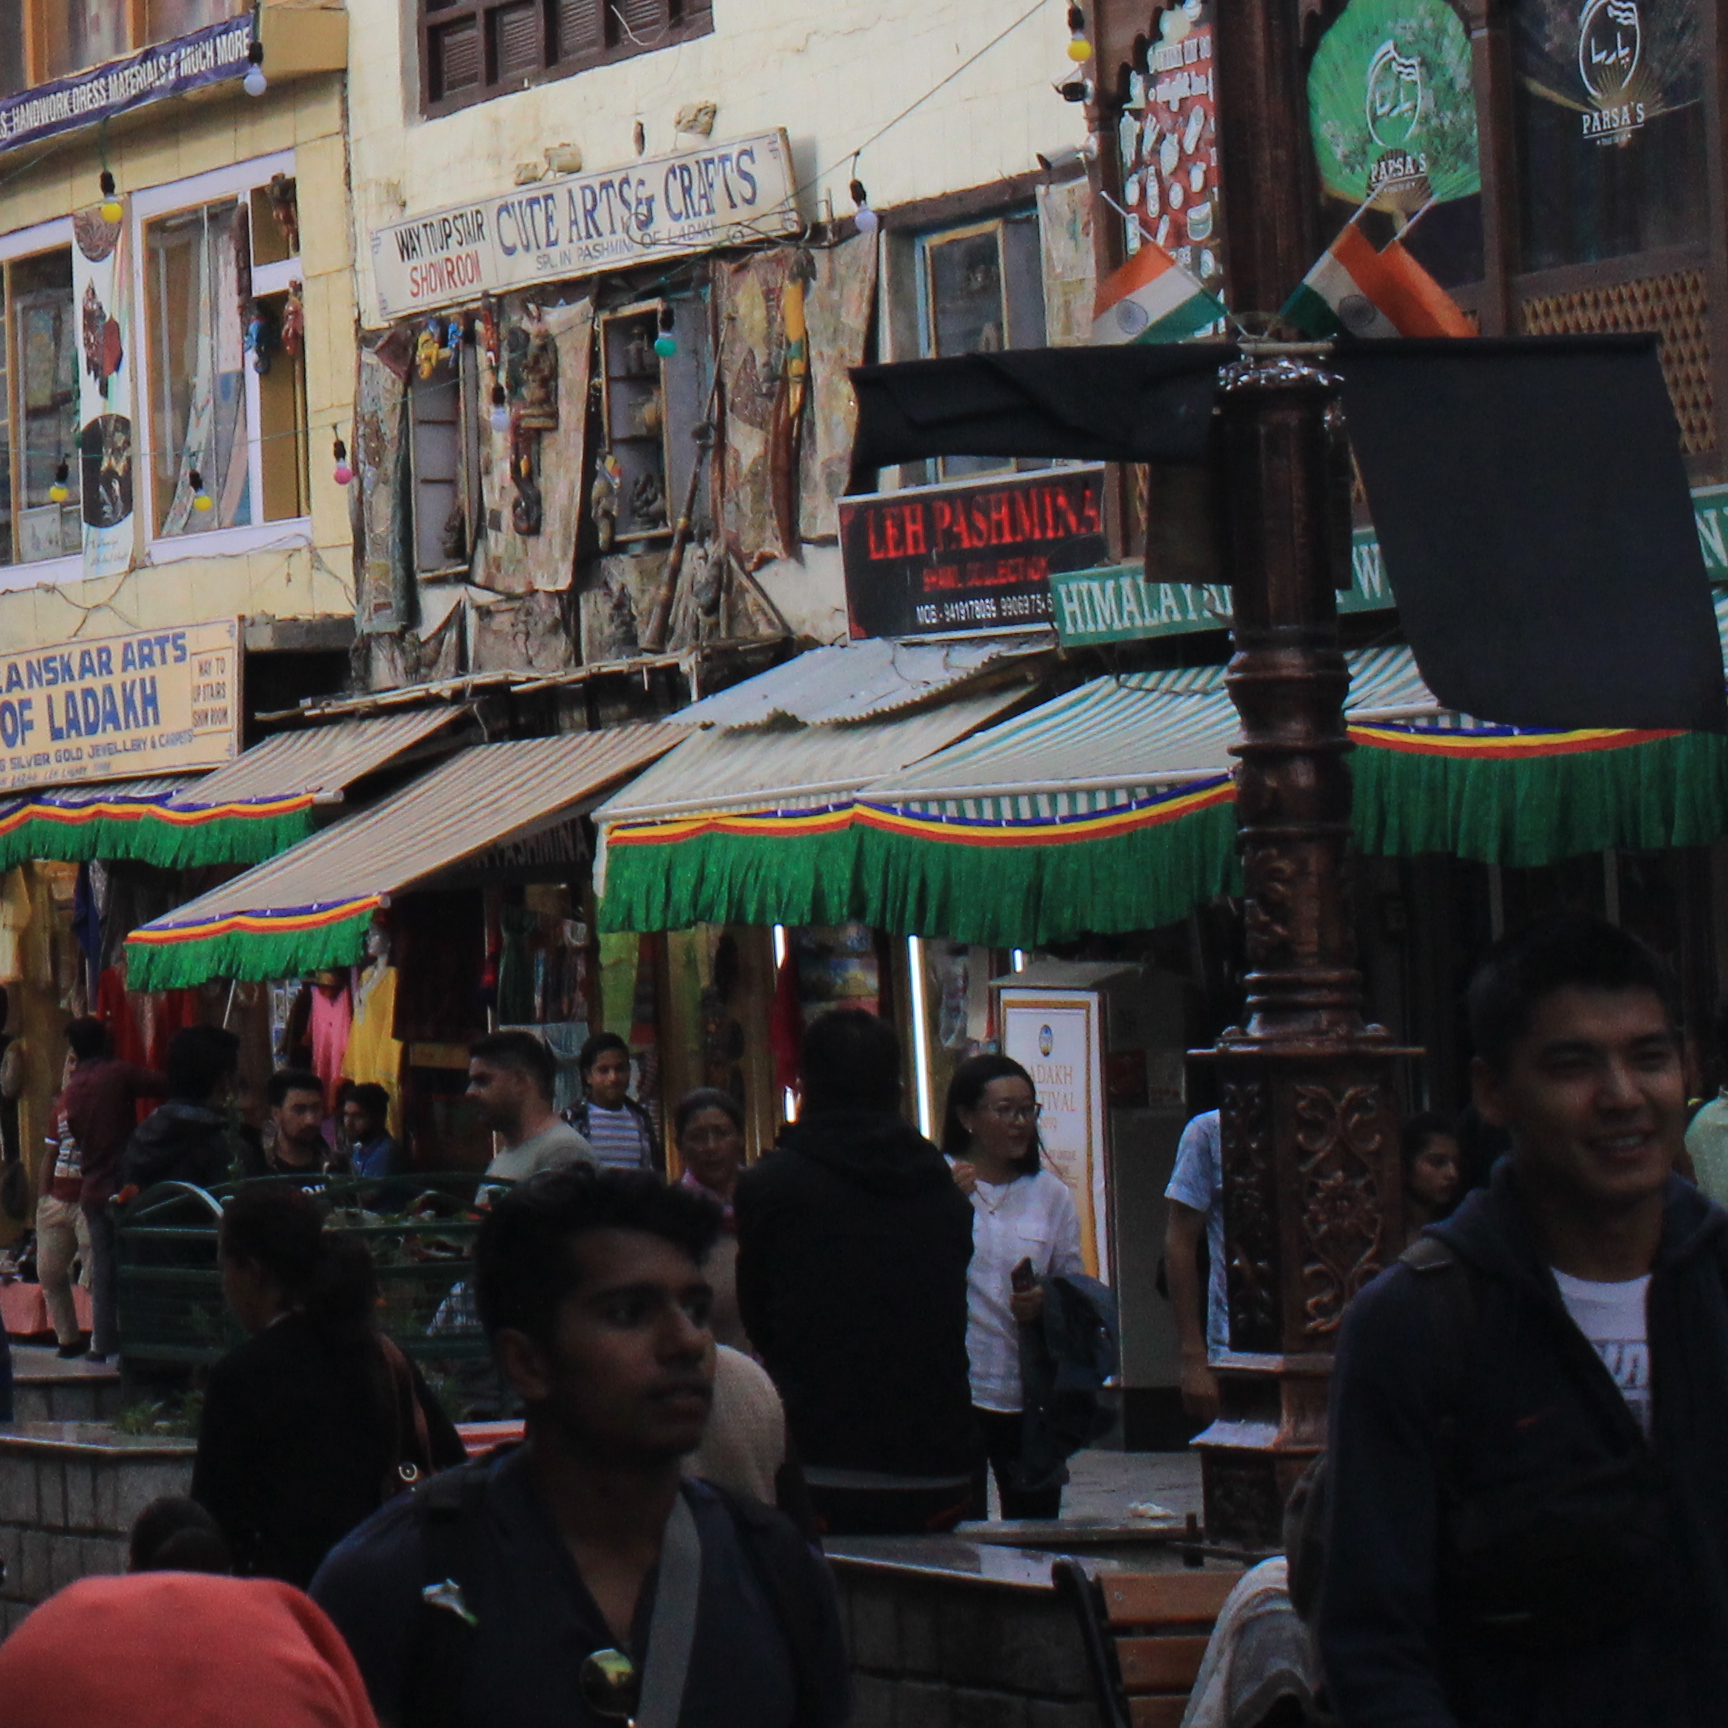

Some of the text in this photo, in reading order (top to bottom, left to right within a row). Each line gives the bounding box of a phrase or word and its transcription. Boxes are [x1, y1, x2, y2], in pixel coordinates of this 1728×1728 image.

[11, 90, 74, 131] HANDWORK
[72, 79, 106, 113] DRESS
[108, 55, 168, 101] MATERIALS
[168, 52, 179, 82] &
[180, 39, 215, 76] MUCH
[216, 26, 251, 64] MORE
[1581, 101, 1645, 136] PARSA'S
[497, 193, 560, 257] CUTE
[568, 172, 632, 244] ARTS
[664, 145, 758, 223] CRAFTS
[395, 225, 424, 263] WAY
[867, 483, 1103, 561] LEH PASHMINA
[121, 631, 188, 673] ARTS
[46, 674, 162, 742] LADAKH
[10, 752, 51, 771] SILVER
[54, 747, 84, 764] GOLD
[87, 738, 149, 759] JEWELLERY
[150, 736, 158, 750] &
[158, 729, 195, 748] CARPETS
[1028, 1063, 1074, 1086] ADAKH
